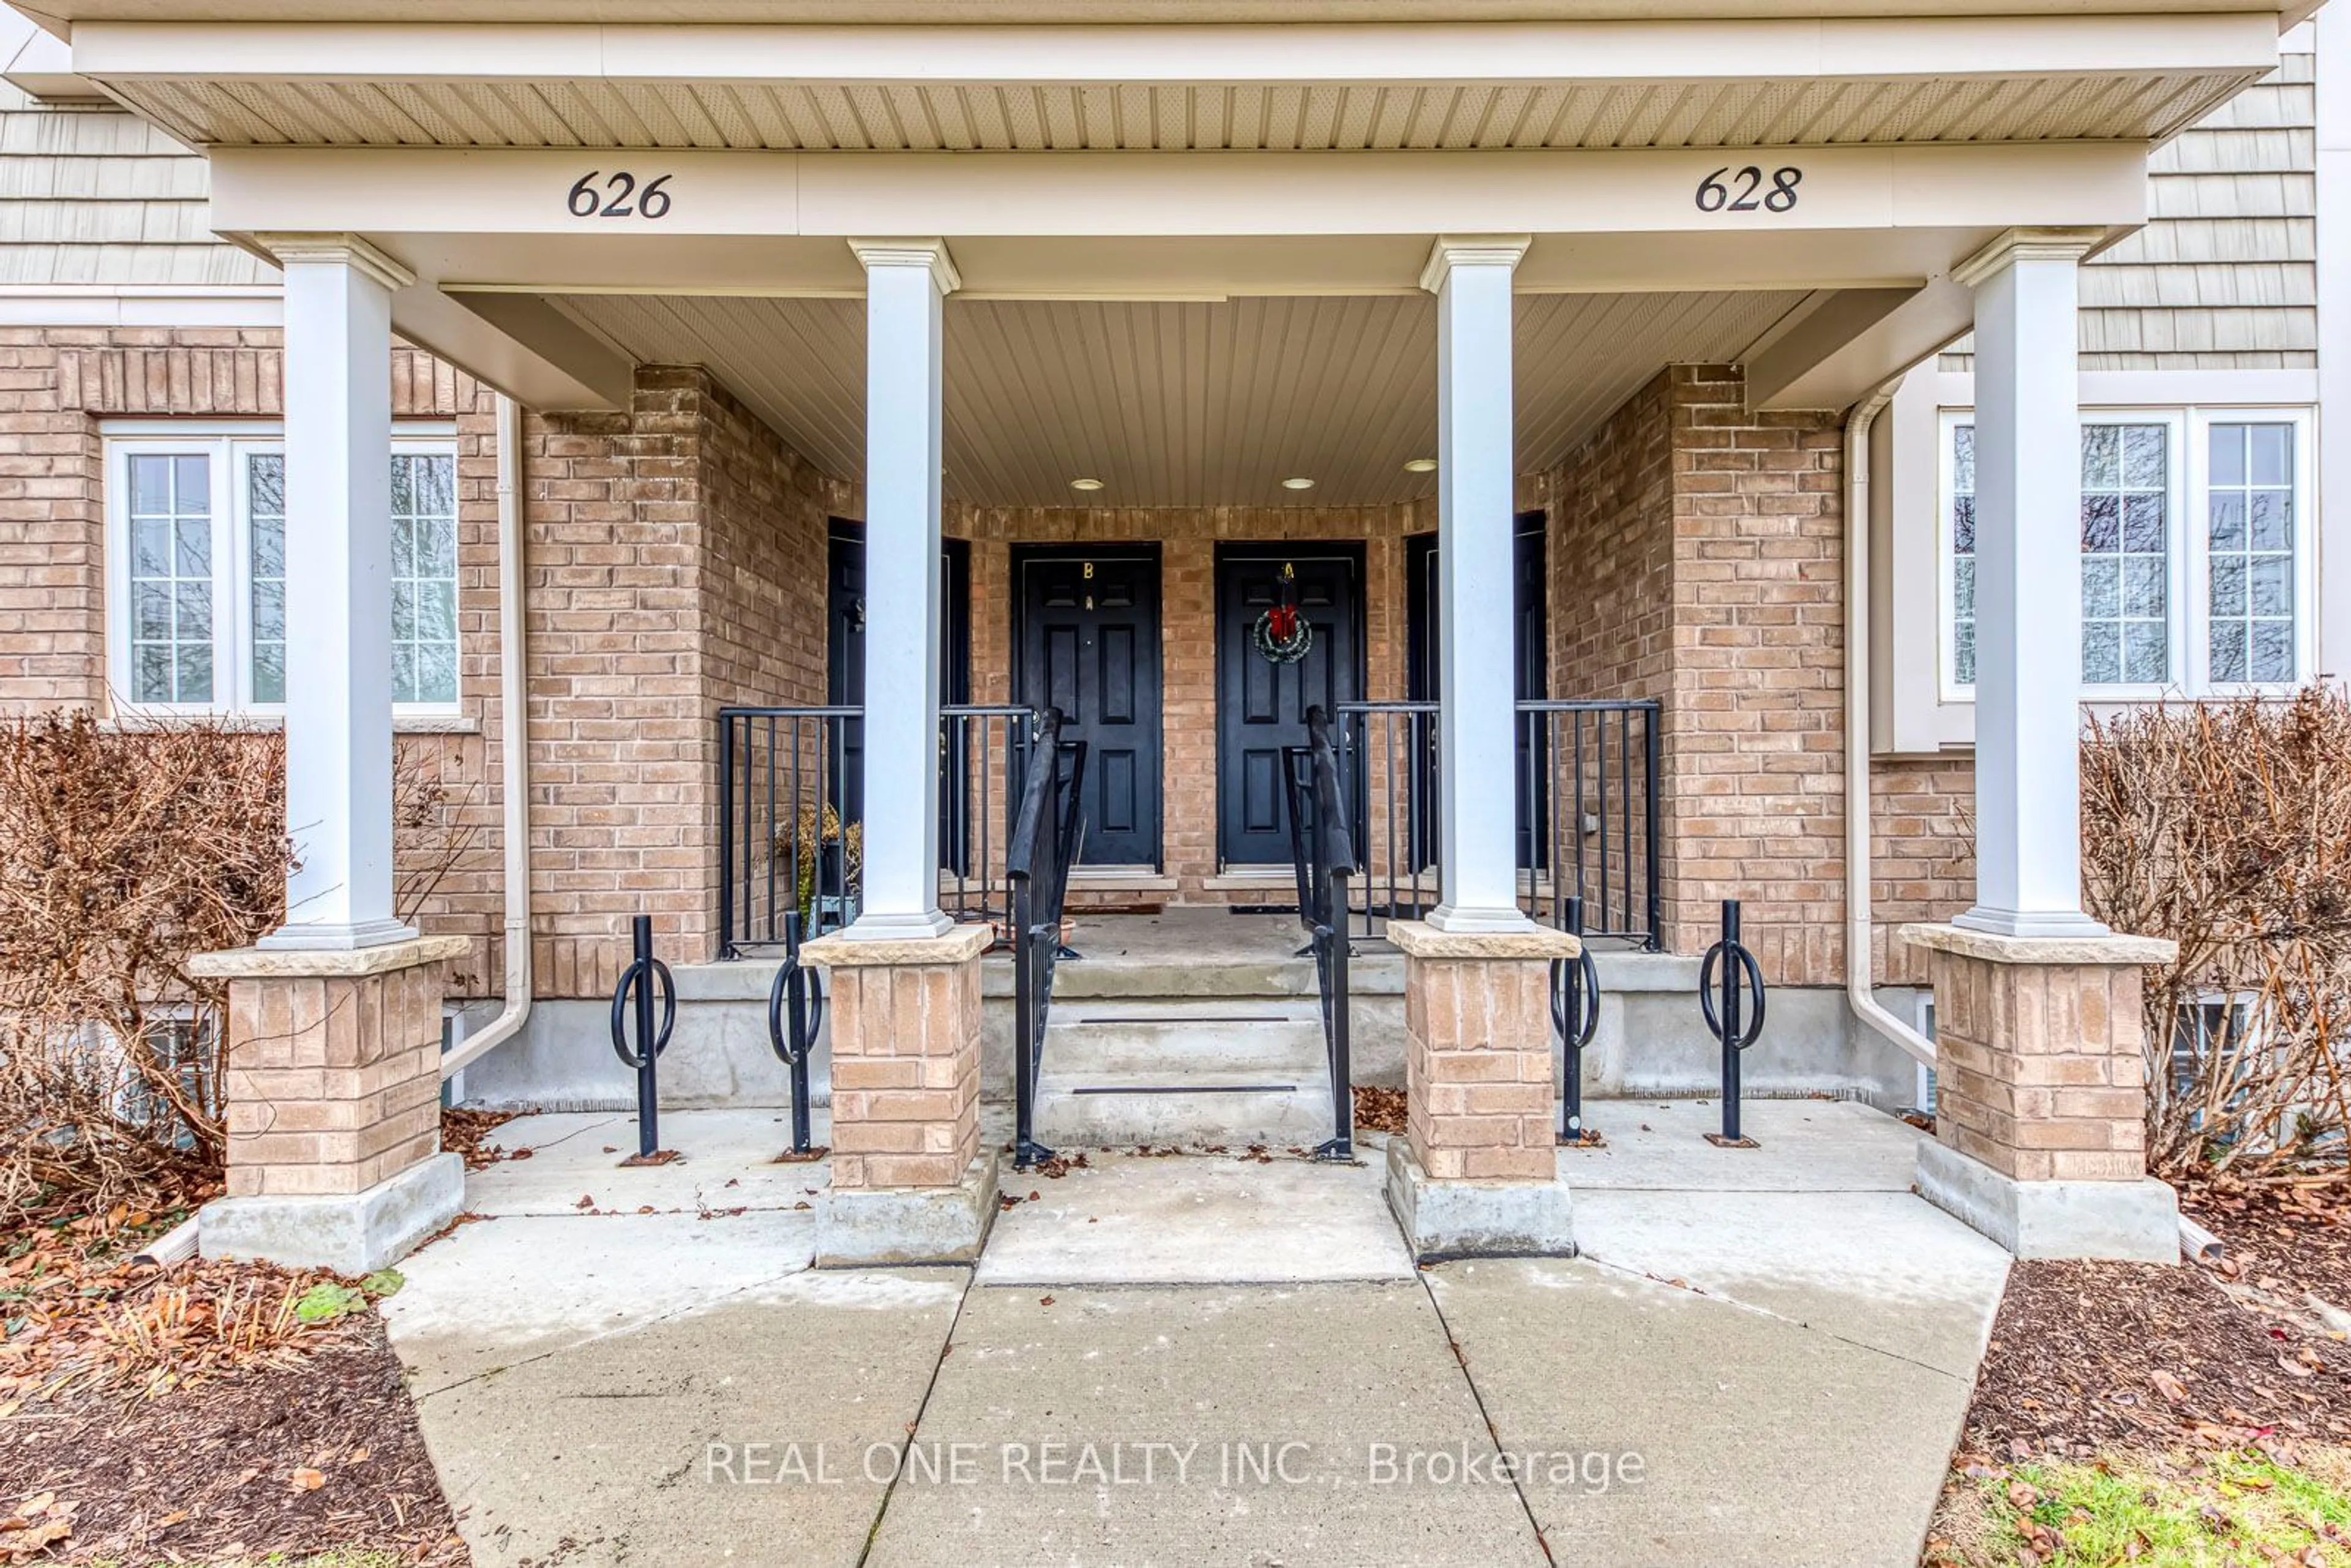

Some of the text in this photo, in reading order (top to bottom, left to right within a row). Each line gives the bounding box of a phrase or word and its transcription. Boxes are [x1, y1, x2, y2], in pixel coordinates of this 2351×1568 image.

[568, 170, 672, 219] 626
[1695, 166, 1802, 212] 628
[1084, 563, 1093, 579] B
